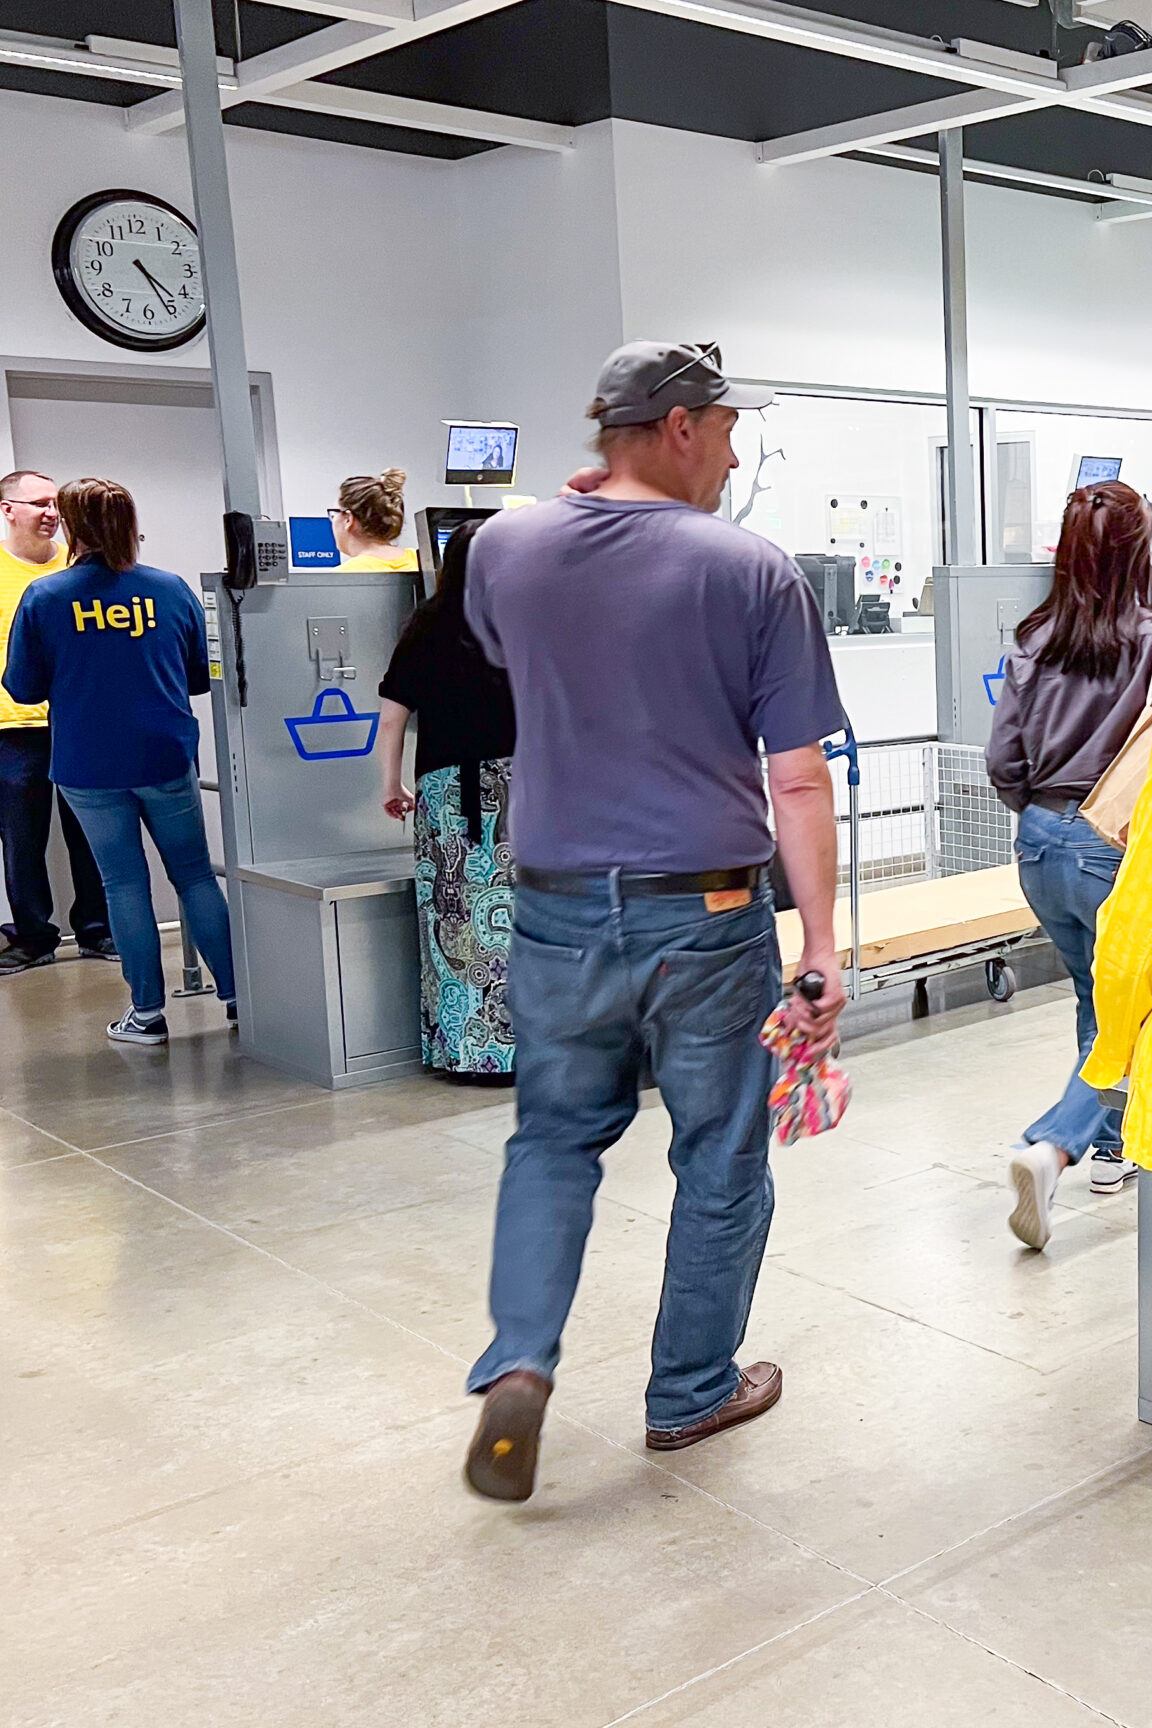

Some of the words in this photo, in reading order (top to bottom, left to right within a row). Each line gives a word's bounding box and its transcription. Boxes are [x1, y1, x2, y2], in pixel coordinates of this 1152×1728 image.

[109, 224, 125, 240] 11
[128, 219, 146, 235] 12
[156, 226, 162, 241] 1
[96, 241, 114, 257] 10
[170, 241, 182, 255] 2
[90, 260, 102, 276] 9
[183, 264, 194, 278] 3
[101, 282, 114, 298] 8
[178, 284, 189, 299] 4
[121, 298, 132, 313] 7
[143, 304, 155, 320] 6
[167, 299, 177, 315] 5
[297, 551, 316, 559] STAFF
[72, 596, 156, 637] Hej!
